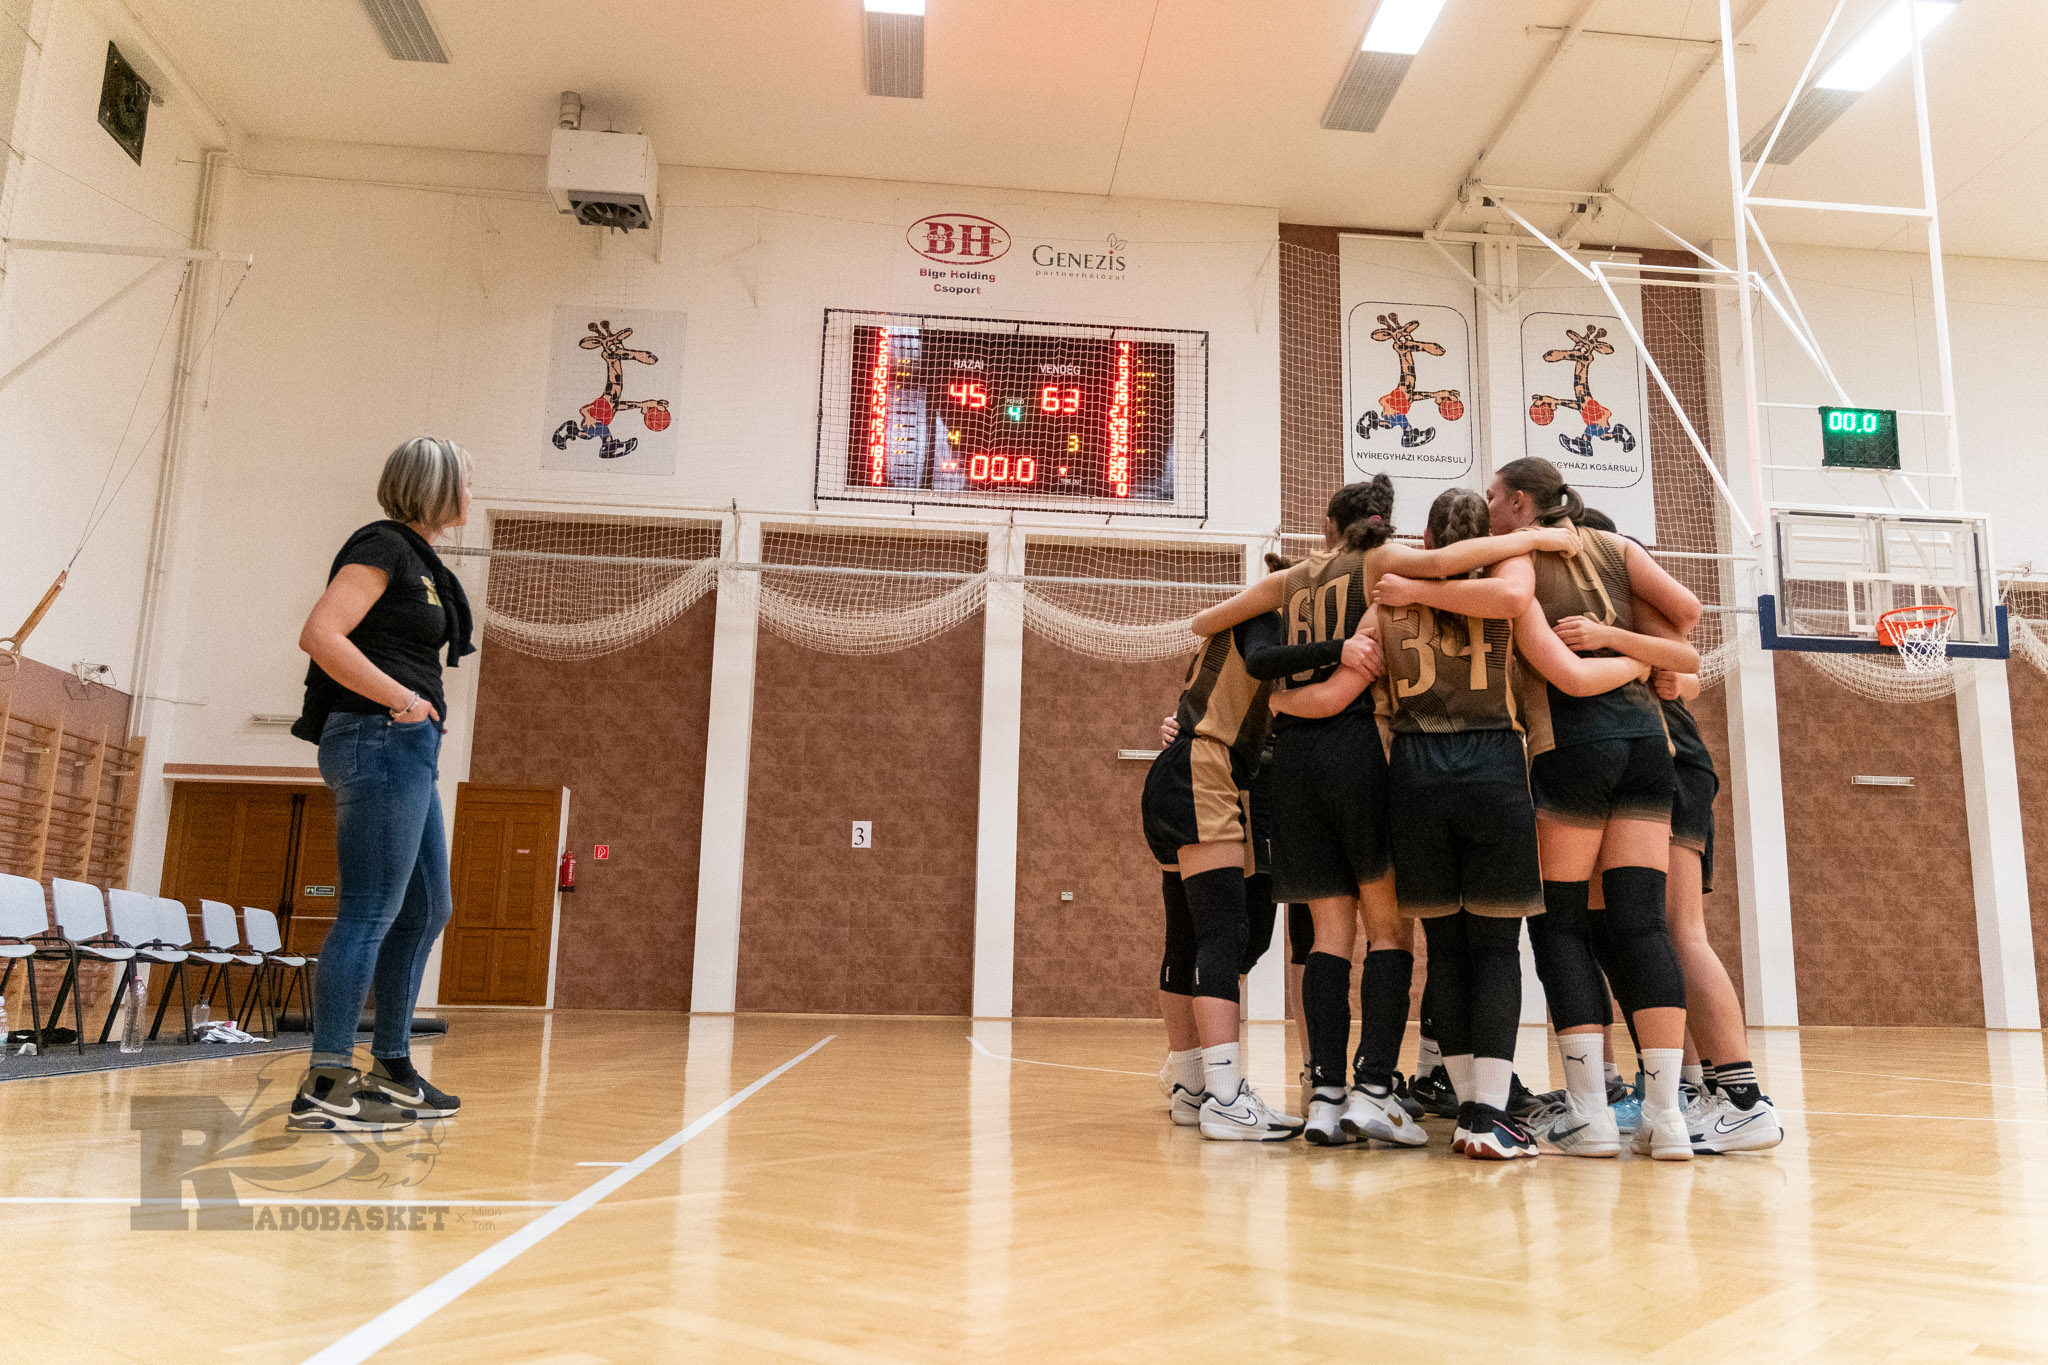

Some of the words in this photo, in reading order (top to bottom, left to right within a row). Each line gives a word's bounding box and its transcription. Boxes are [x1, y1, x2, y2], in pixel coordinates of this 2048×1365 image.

[924, 222, 995, 257] BH
[919, 268, 946, 279] Bige
[950, 270, 996, 283] Holding
[933, 283, 982, 295] Csoport
[953, 358, 984, 370] HAZAI
[950, 383, 987, 407] 45
[1043, 387, 1080, 412] 63
[1008, 406, 1021, 421] 4
[1829, 411, 1876, 432] 00.0
[947, 430, 960, 445] 4
[970, 455, 1035, 482] 00.0
[1392, 603, 1492, 698] 34
[854, 827, 864, 846] 3
